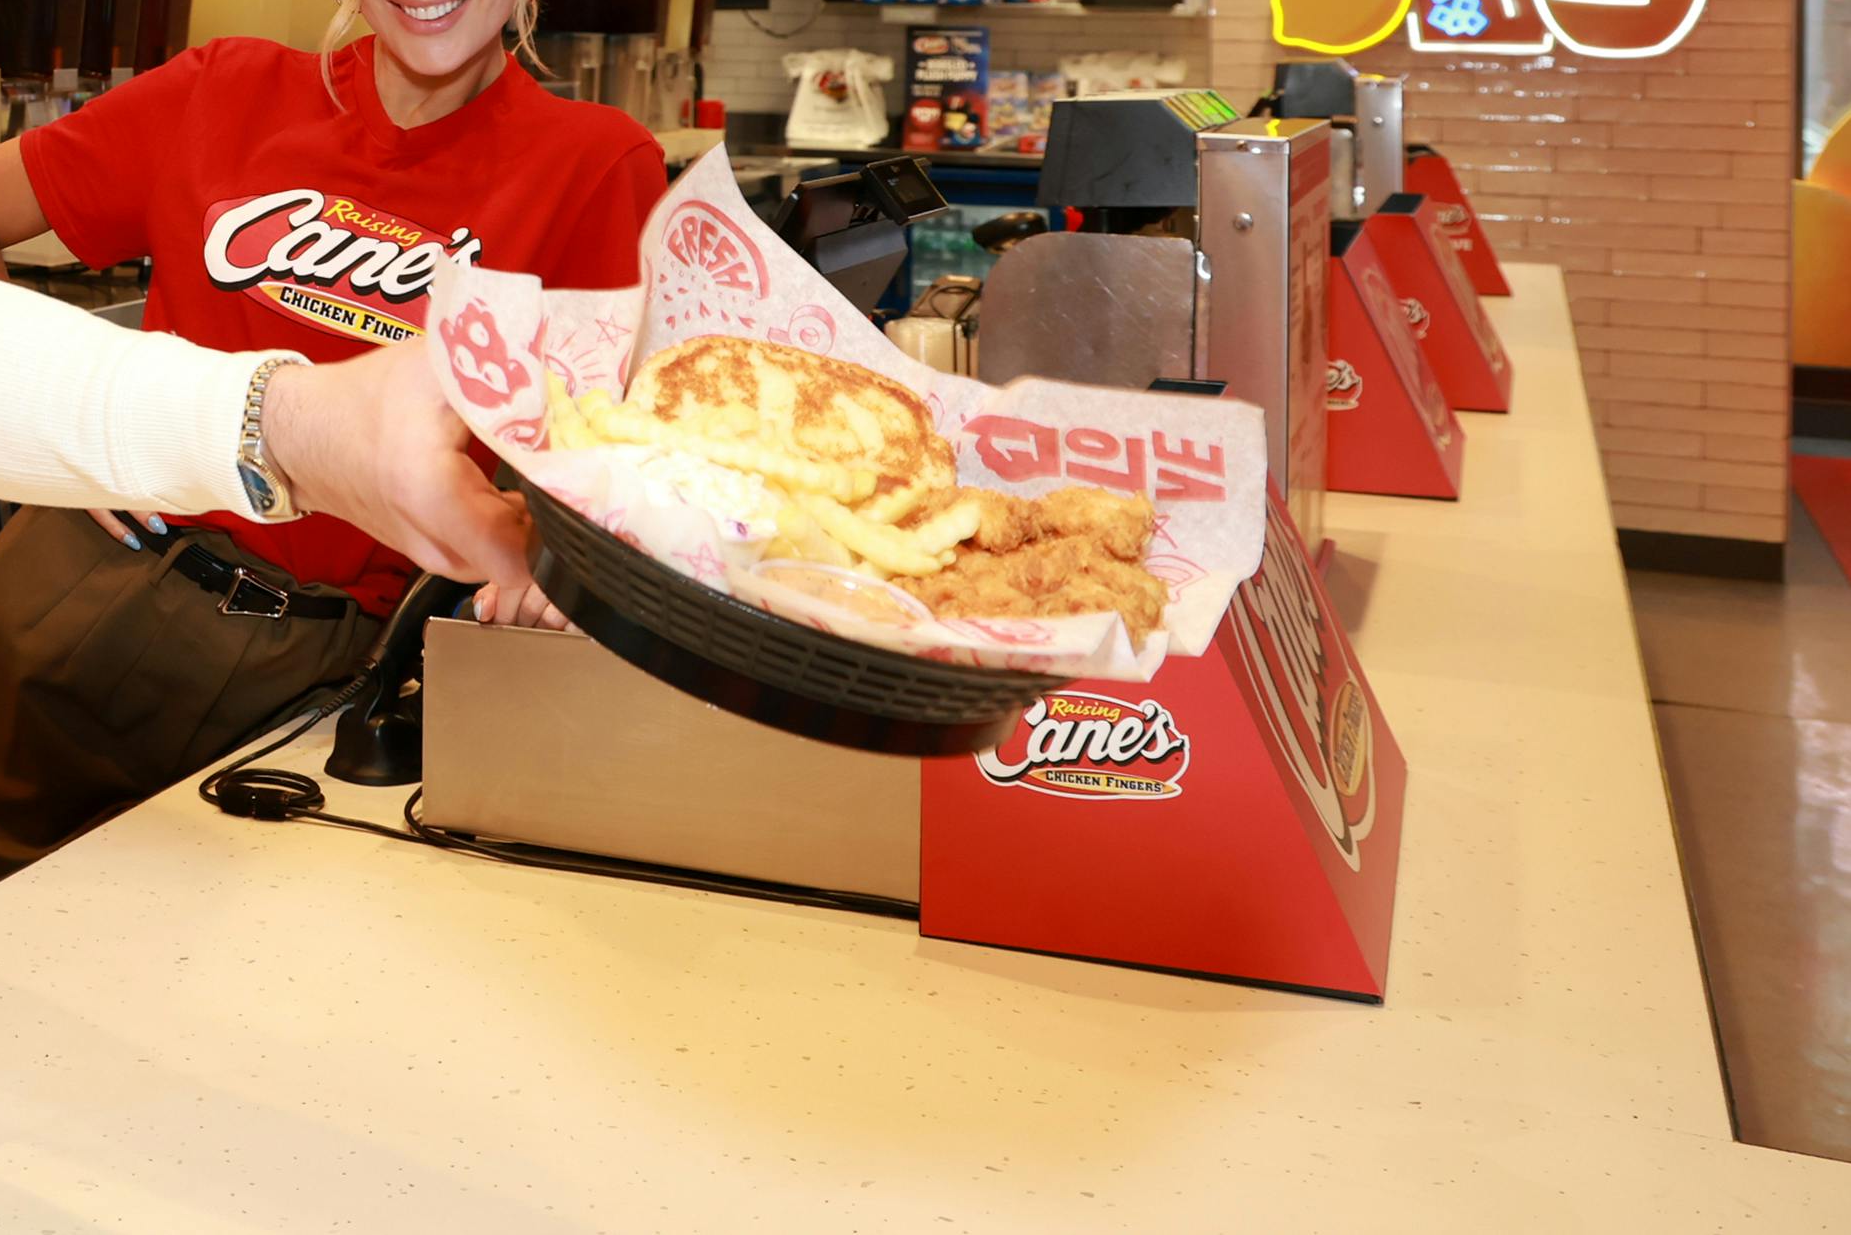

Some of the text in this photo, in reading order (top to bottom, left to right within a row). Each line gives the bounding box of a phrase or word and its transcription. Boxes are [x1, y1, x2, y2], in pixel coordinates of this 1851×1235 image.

[204, 189, 481, 295] Cane's
[324, 199, 422, 246] Raising
[667, 216, 754, 291] FRESH
[280, 286, 421, 342] CHICKEN FINGE
[1050, 698, 1122, 722] Raising
[1046, 769, 1163, 792] CHICKEN FINGERS
